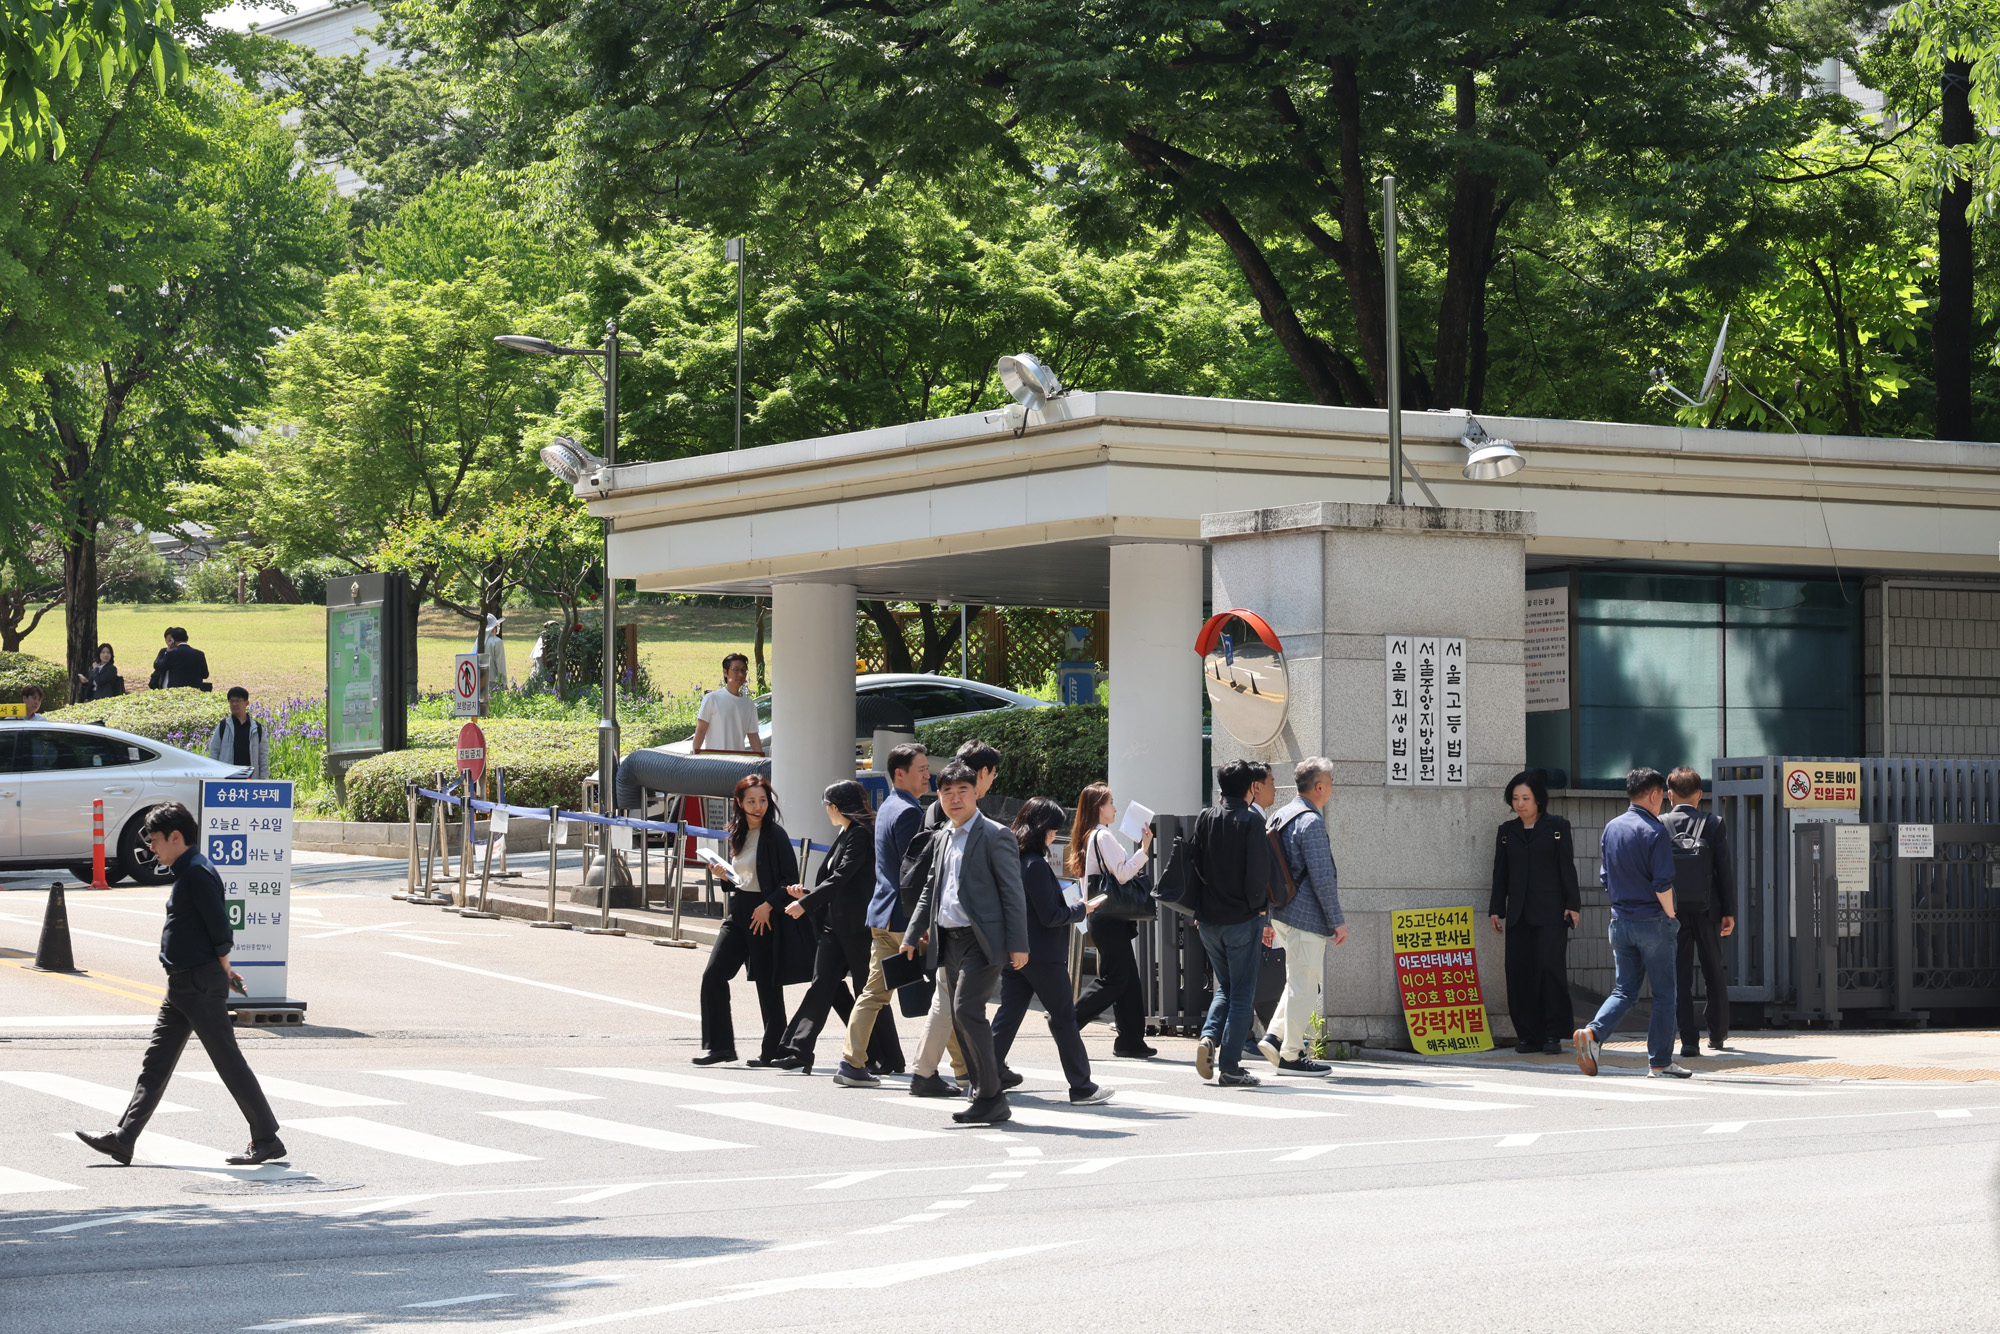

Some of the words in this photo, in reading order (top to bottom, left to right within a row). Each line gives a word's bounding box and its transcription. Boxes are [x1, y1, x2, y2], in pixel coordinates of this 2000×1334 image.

[0, 706, 19, 716] 서울
[456, 700, 476, 711] 보행금지
[1391, 640, 1408, 781] 서울회생법원
[1419, 641, 1435, 782] 서울중앙지방법원
[1446, 641, 1463, 782] 서울고등법원
[460, 749, 480, 760] 진입금지
[1814, 771, 1856, 784] 오토바이
[216, 788, 249, 802] 승용차
[252, 788, 280, 802] 5부제
[1814, 788, 1856, 800] 진입금지
[208, 818, 240, 830] 오늘은
[249, 818, 282, 832] 수요일
[212, 840, 244, 864] 3,8
[248, 848, 270, 861] 쉬는
[273, 848, 284, 861] 날
[248, 882, 281, 896] 목요일
[246, 912, 267, 924] 쉬는
[271, 912, 282, 925] 날
[1397, 912, 1468, 929] 25고단6414
[1396, 932, 1432, 949] 박강균
[1435, 929, 1471, 946] 판사님
[1399, 951, 1474, 970] 아도인터네셔널
[1410, 1008, 1484, 1037] 강력처벌
[1426, 1036, 1480, 1052] 해주세요!!!
